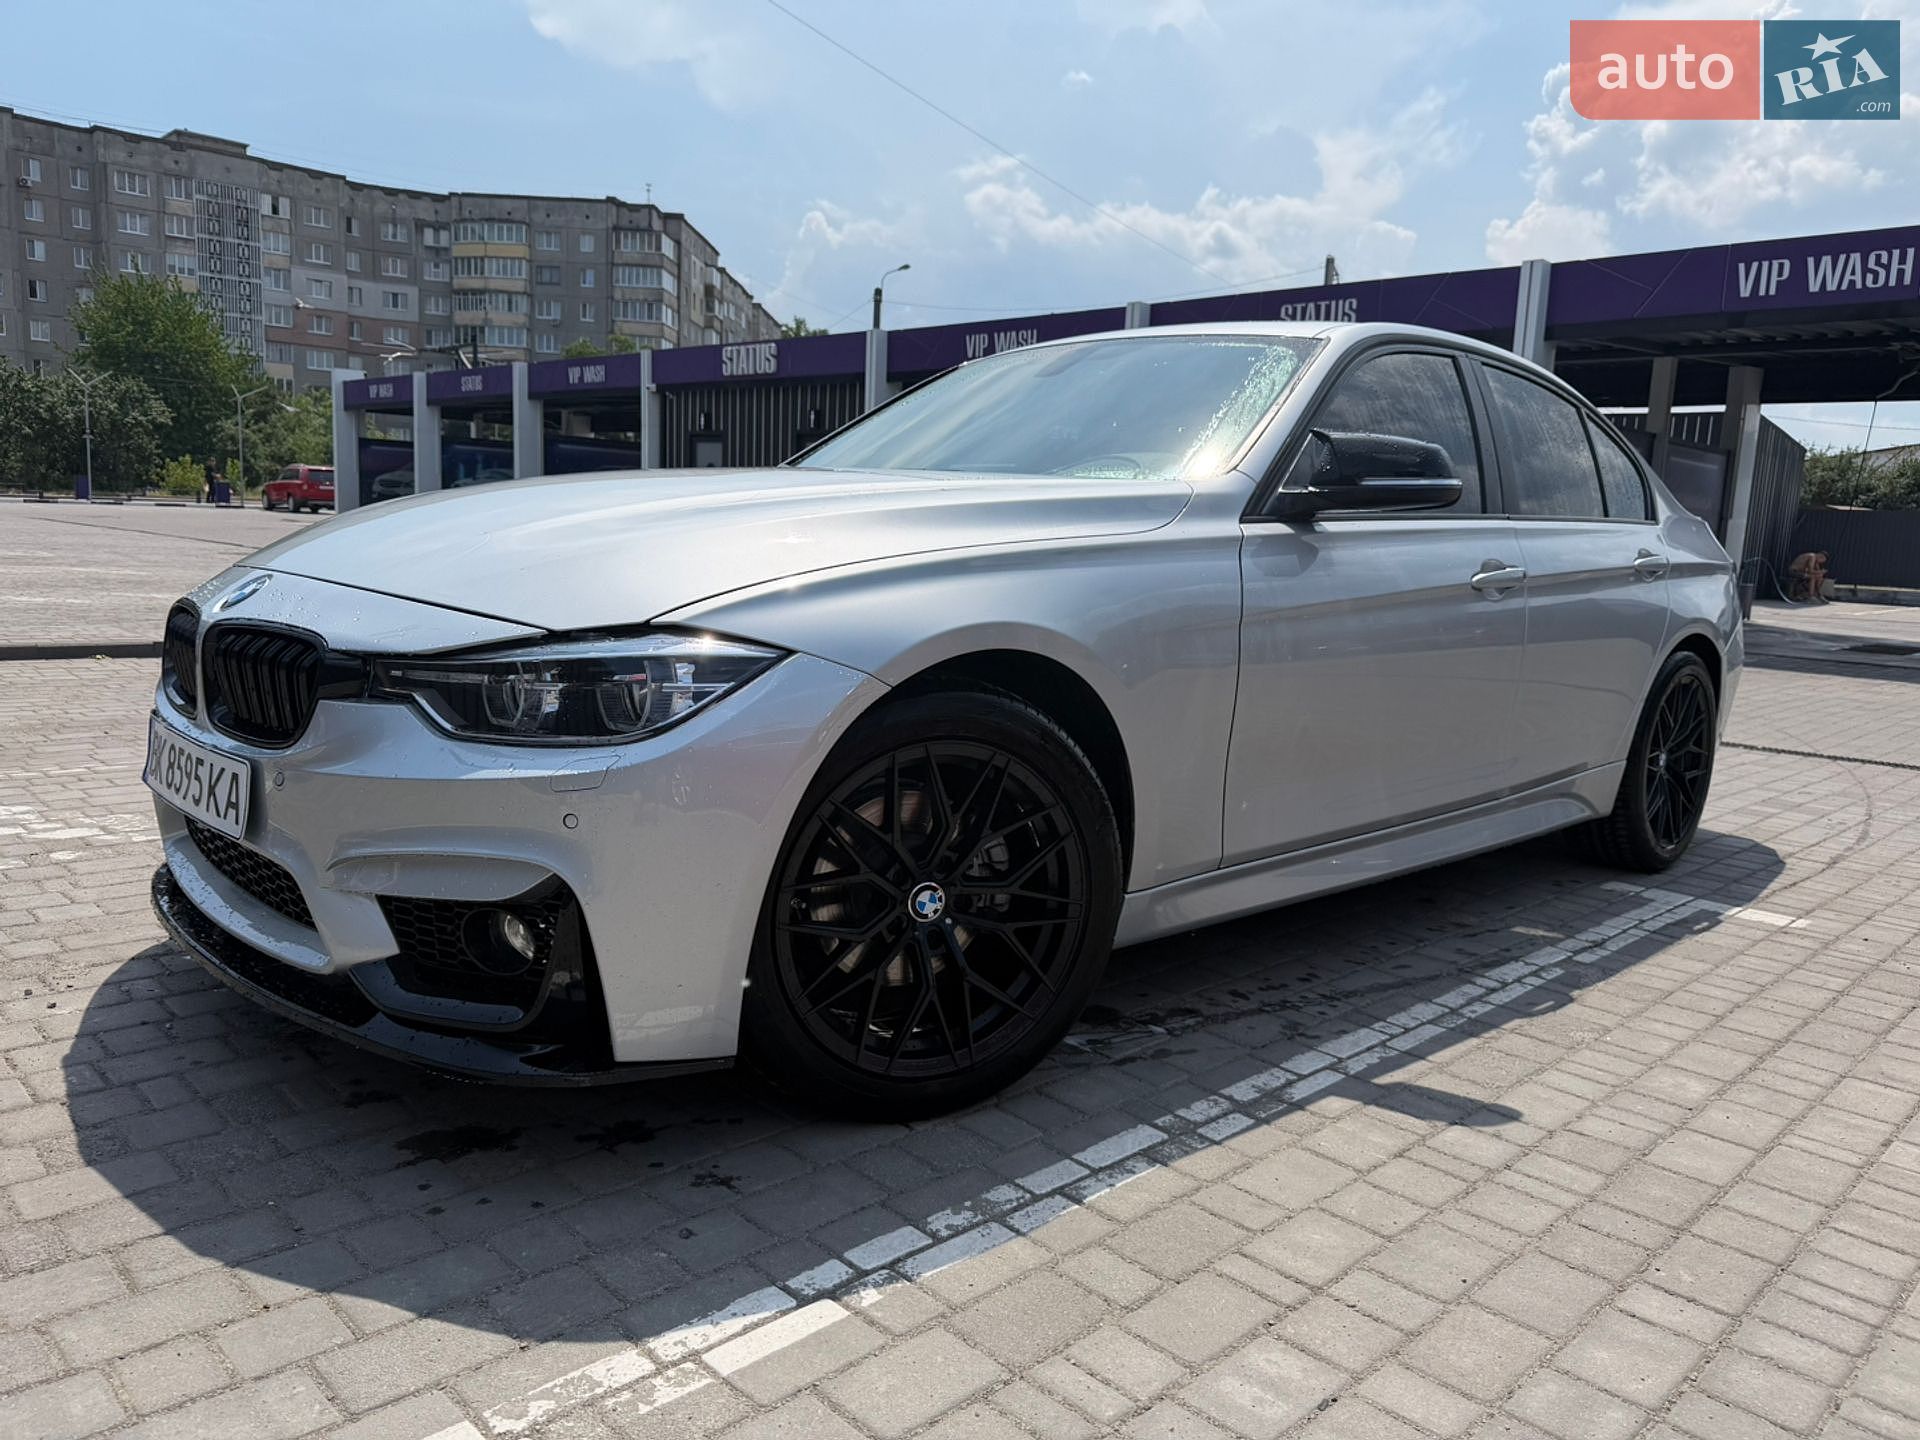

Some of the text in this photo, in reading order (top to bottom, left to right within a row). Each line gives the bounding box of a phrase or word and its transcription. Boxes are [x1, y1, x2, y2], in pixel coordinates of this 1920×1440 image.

[1738, 247, 1915, 298] VIP WASH
[1280, 298, 1358, 322] STATUS
[722, 342, 778, 376] STATUS
[966, 328, 1038, 359] VIP WASH
[568, 364, 606, 384] VIP WASH
[166, 743, 205, 808] 8595
[206, 762, 240, 826] KA
